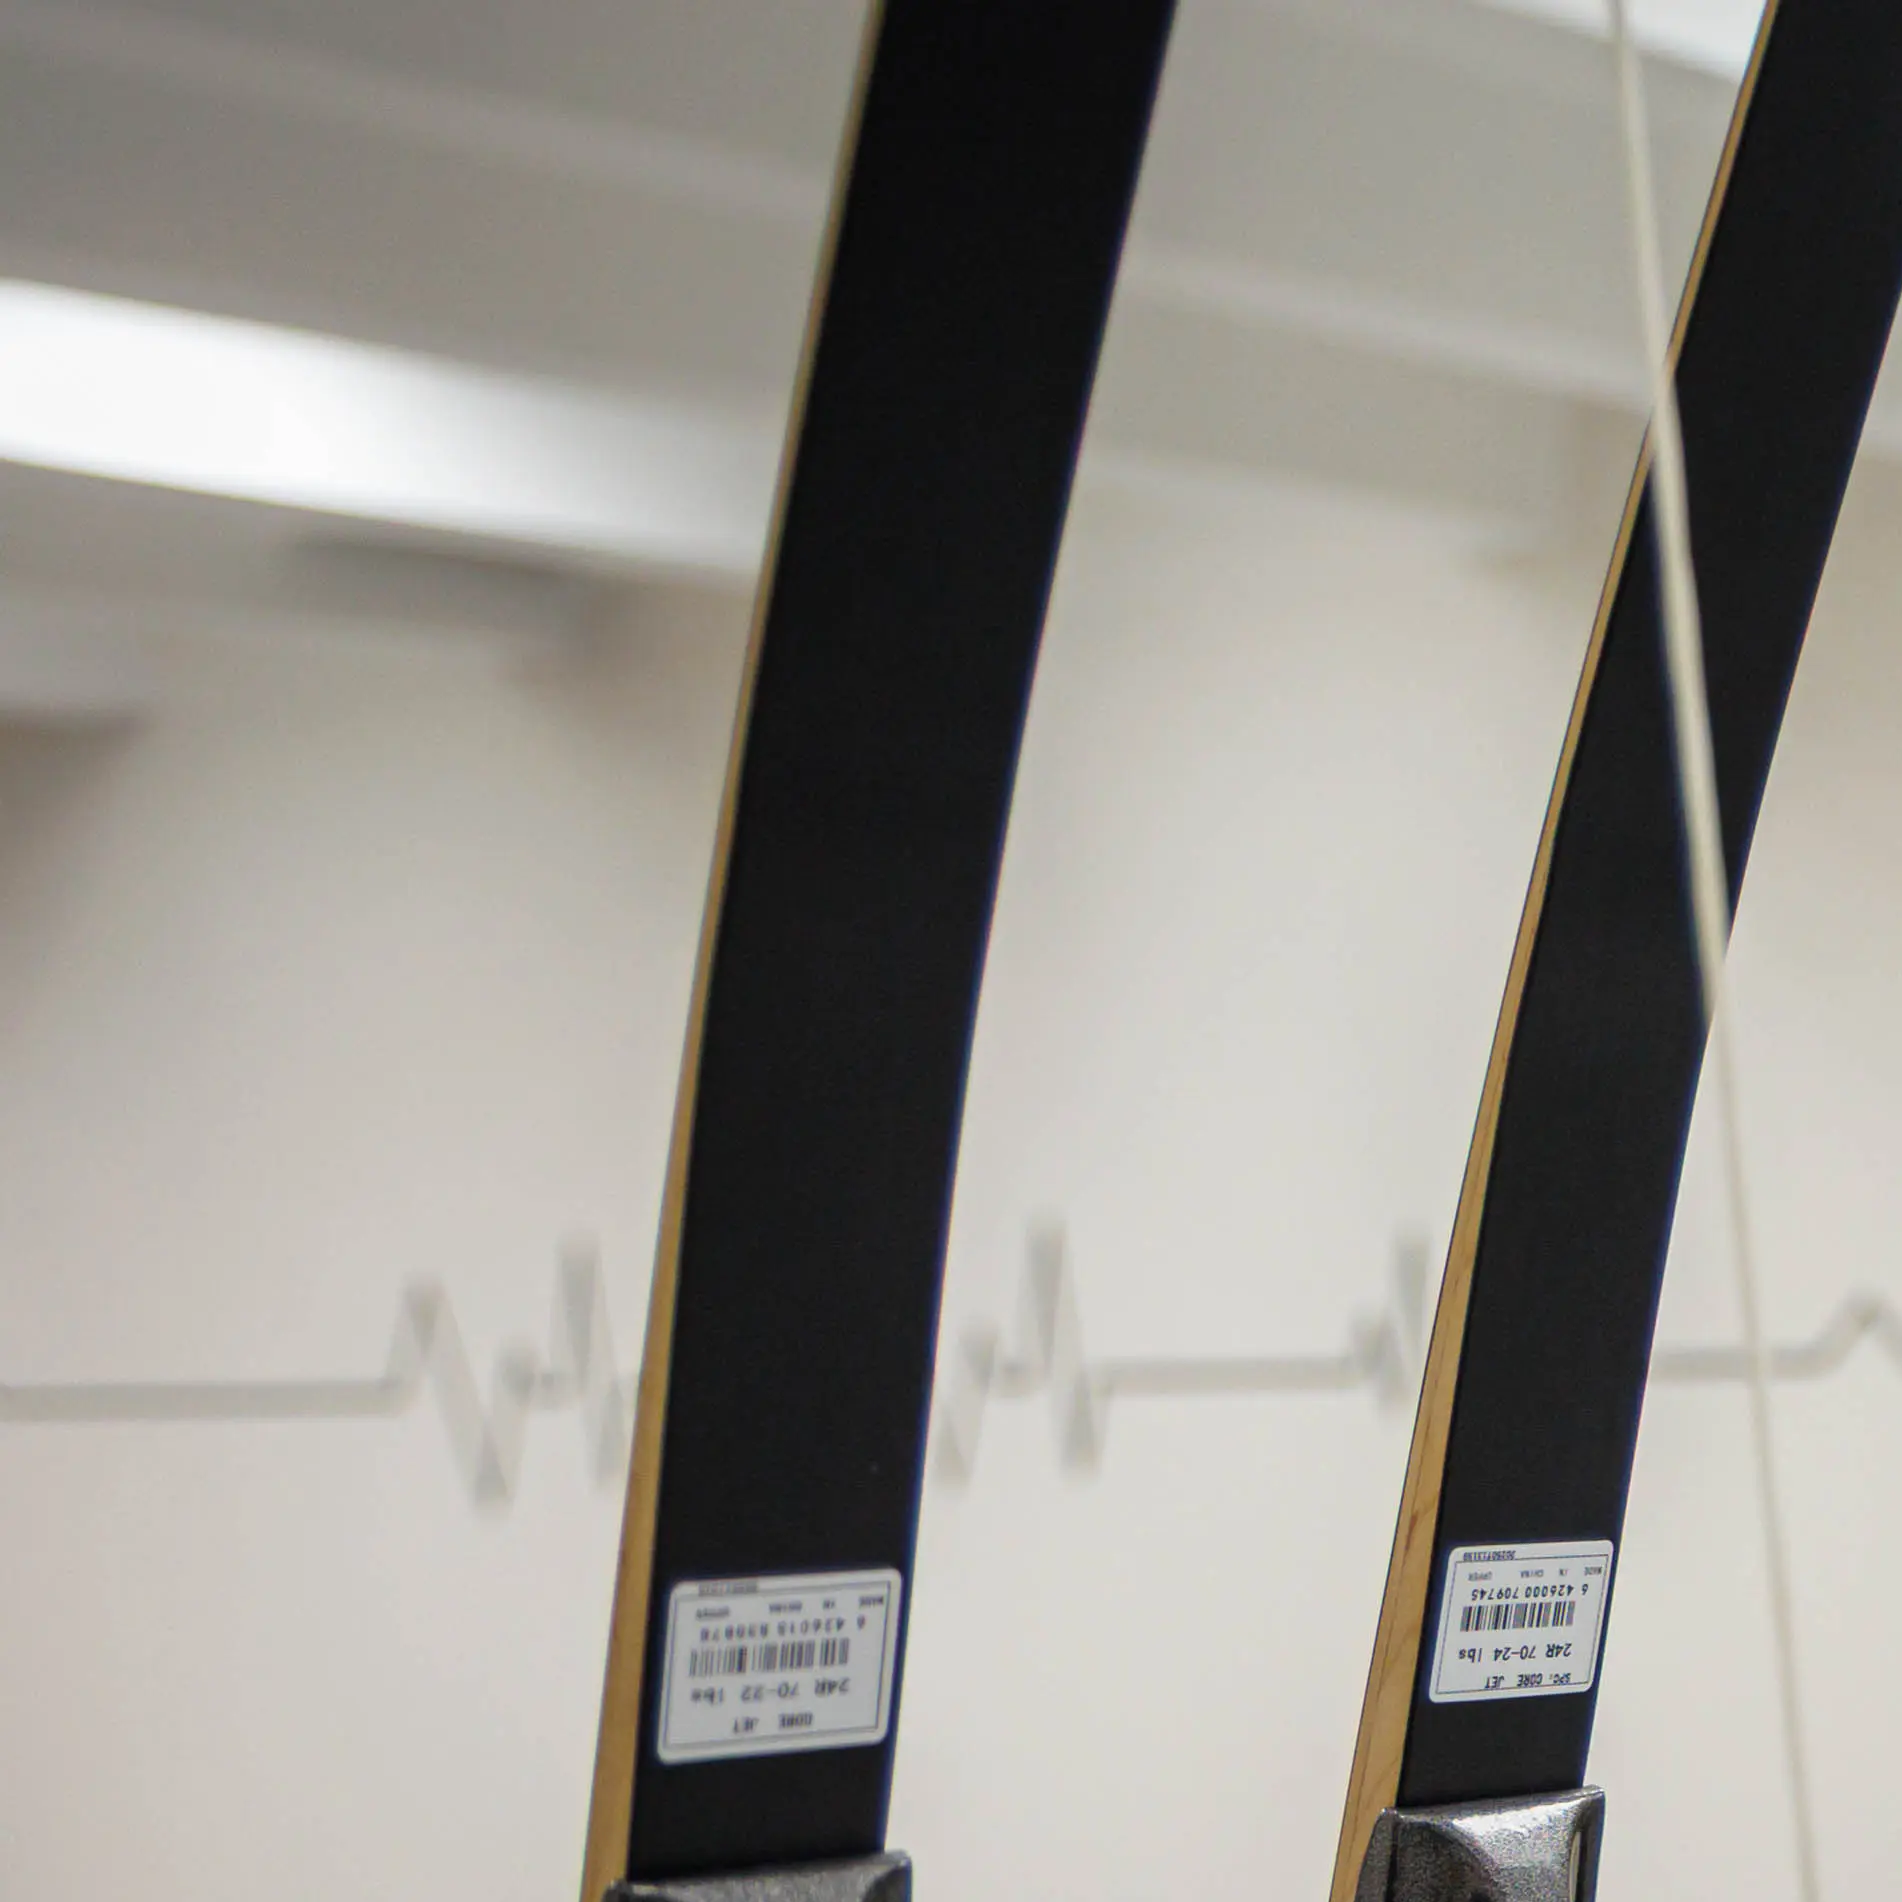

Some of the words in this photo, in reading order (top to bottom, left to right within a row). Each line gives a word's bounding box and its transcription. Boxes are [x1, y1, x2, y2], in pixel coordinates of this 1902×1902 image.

[1471, 1587, 1519, 1601] 709745
[1525, 1584, 1574, 1598] 426000
[1582, 1583, 1589, 1595] 6
[1458, 1648, 1482, 1663] lbs
[1493, 1645, 1536, 1661] 70-24
[1545, 1643, 1572, 1658] 24R
[1484, 1676, 1504, 1689] JET
[1517, 1673, 1542, 1686] CORE
[740, 1681, 799, 1702] 70-22
[814, 1678, 851, 1698] 24R
